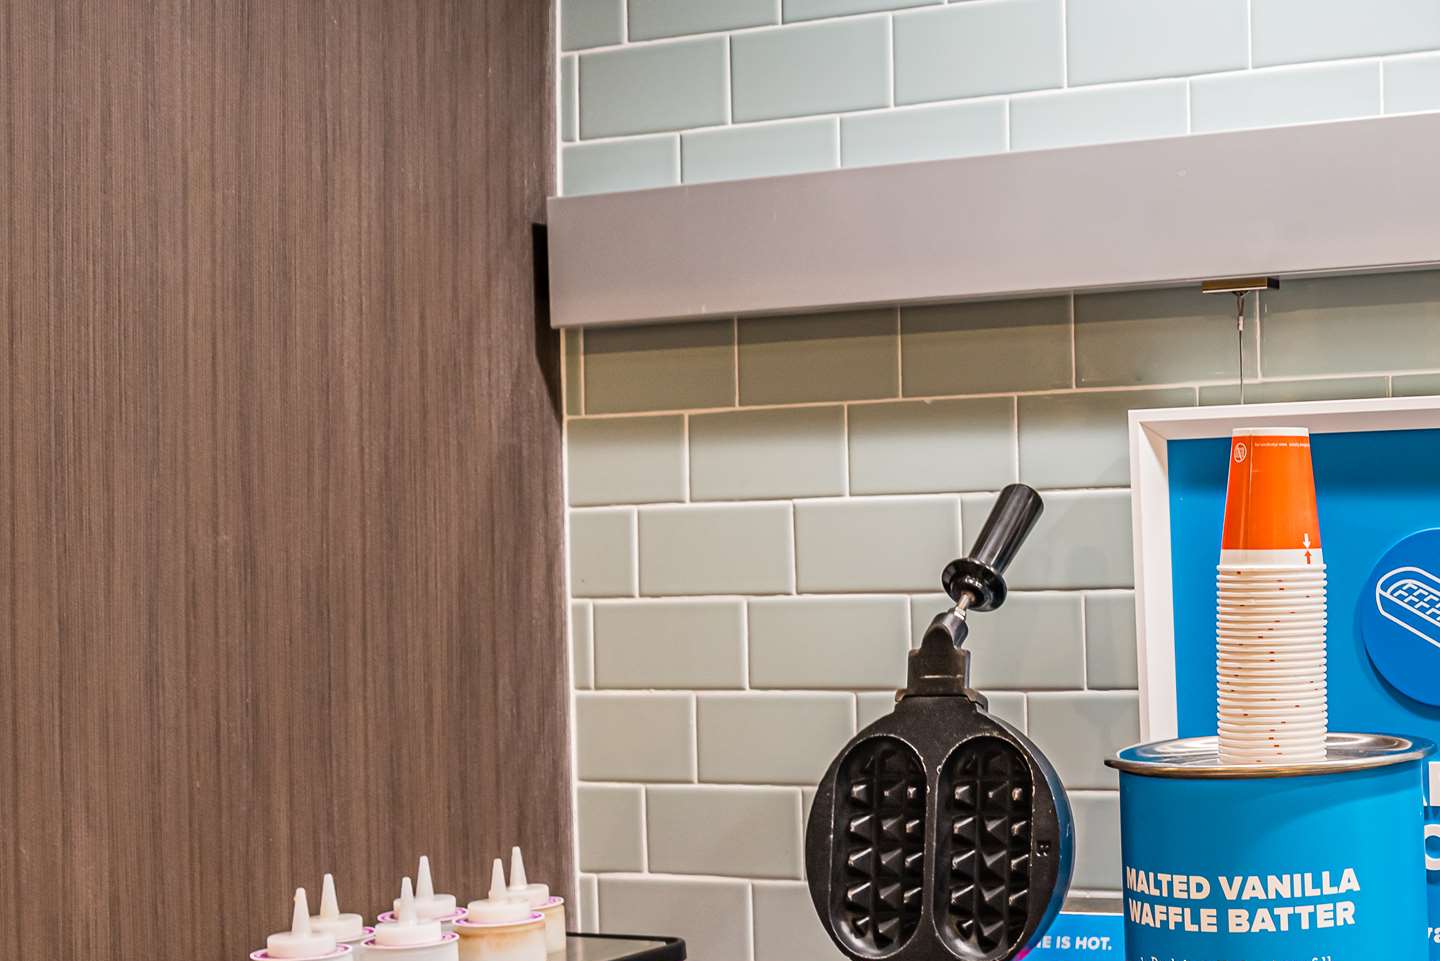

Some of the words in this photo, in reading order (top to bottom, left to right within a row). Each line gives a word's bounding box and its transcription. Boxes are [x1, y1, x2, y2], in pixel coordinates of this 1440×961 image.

[1126, 866, 1211, 900] MALTED
[1218, 867, 1361, 900] VANILLA
[1128, 898, 1218, 933] WAFFLE
[1227, 901, 1356, 934] BATTER
[1056, 935, 1071, 949] IS
[1075, 936, 1112, 951] HOT.
